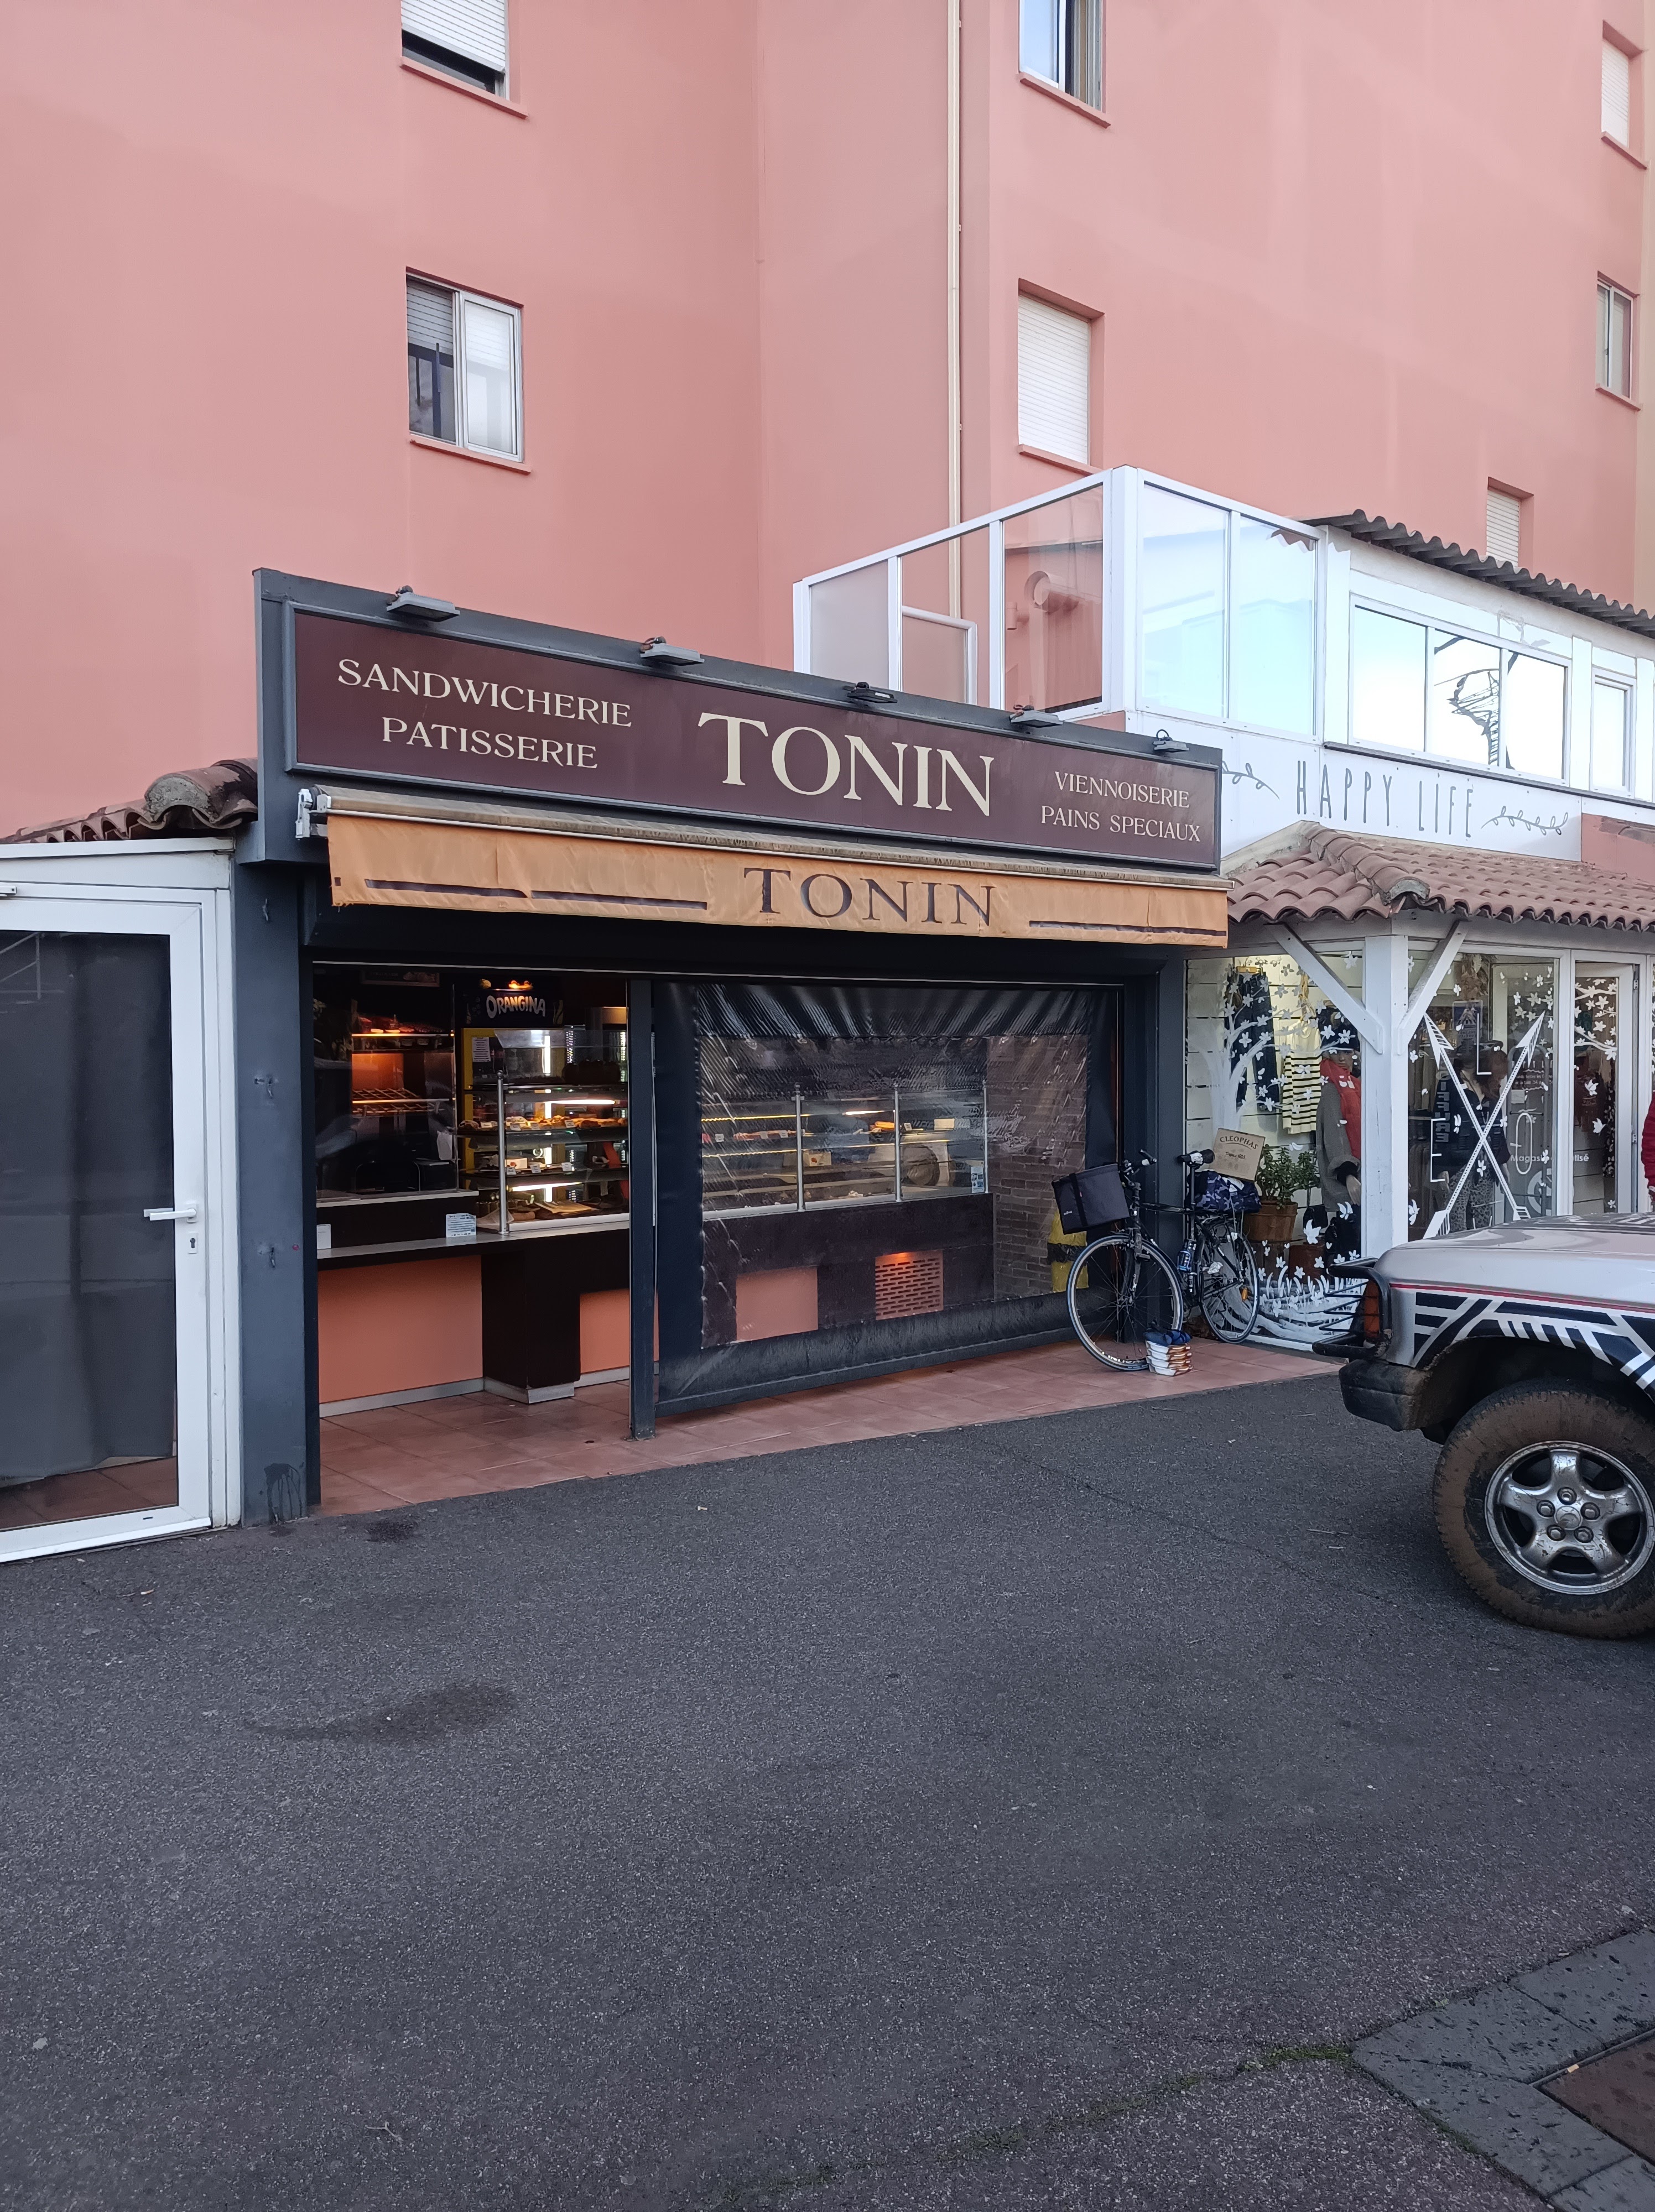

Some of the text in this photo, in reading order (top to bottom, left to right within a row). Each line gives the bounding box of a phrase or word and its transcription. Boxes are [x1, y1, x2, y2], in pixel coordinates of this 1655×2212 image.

[337, 659, 632, 728] SANDWICHERIE
[382, 717, 598, 769] PATISSERIE
[698, 712, 994, 816] TONIN
[1054, 771, 1190, 808] VIENNOISERIE
[1297, 760, 1474, 838] HAPPY LIFE
[1041, 806, 1201, 842] PAINS SPECIAUX
[743, 867, 997, 927] TONIN
[486, 995, 546, 1019] ORANGINA
[1220, 1135, 1258, 1149] CLEOPHAS
